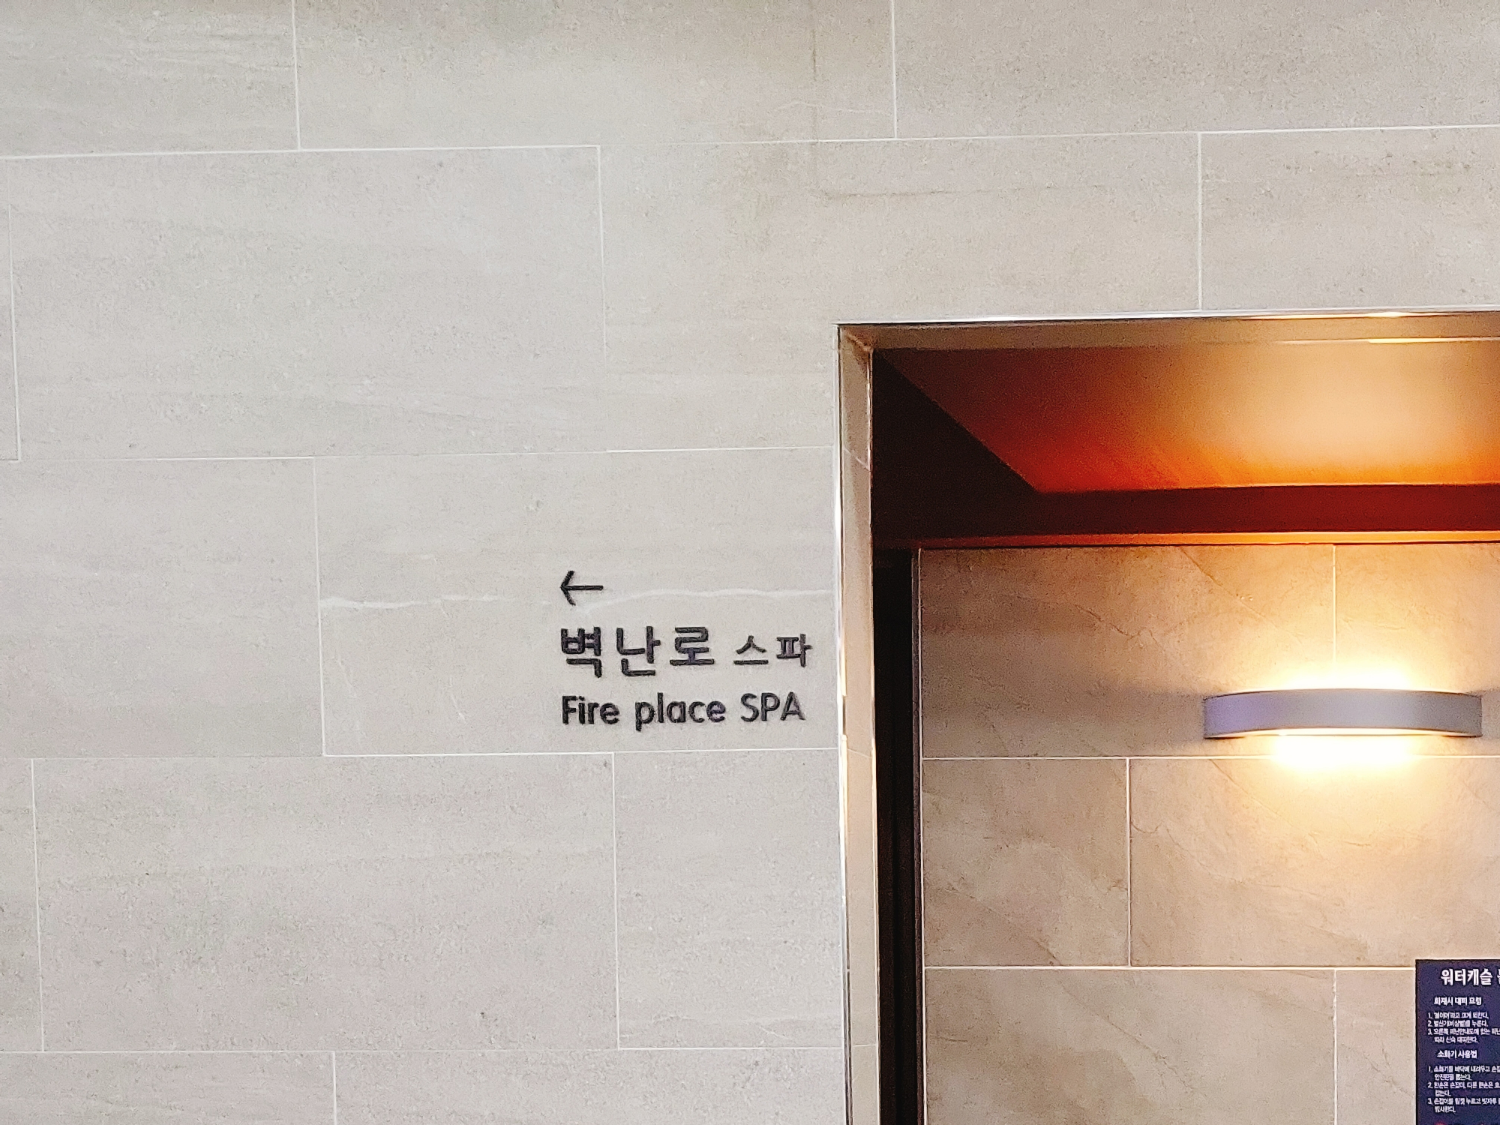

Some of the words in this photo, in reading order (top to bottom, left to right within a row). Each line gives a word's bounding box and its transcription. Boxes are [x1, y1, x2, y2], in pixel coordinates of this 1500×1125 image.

[560, 625, 716, 679] 벽난로
[733, 633, 813, 668] 스파
[561, 695, 620, 725] Fire
[634, 692, 726, 732] place
[740, 692, 806, 723] SPA
